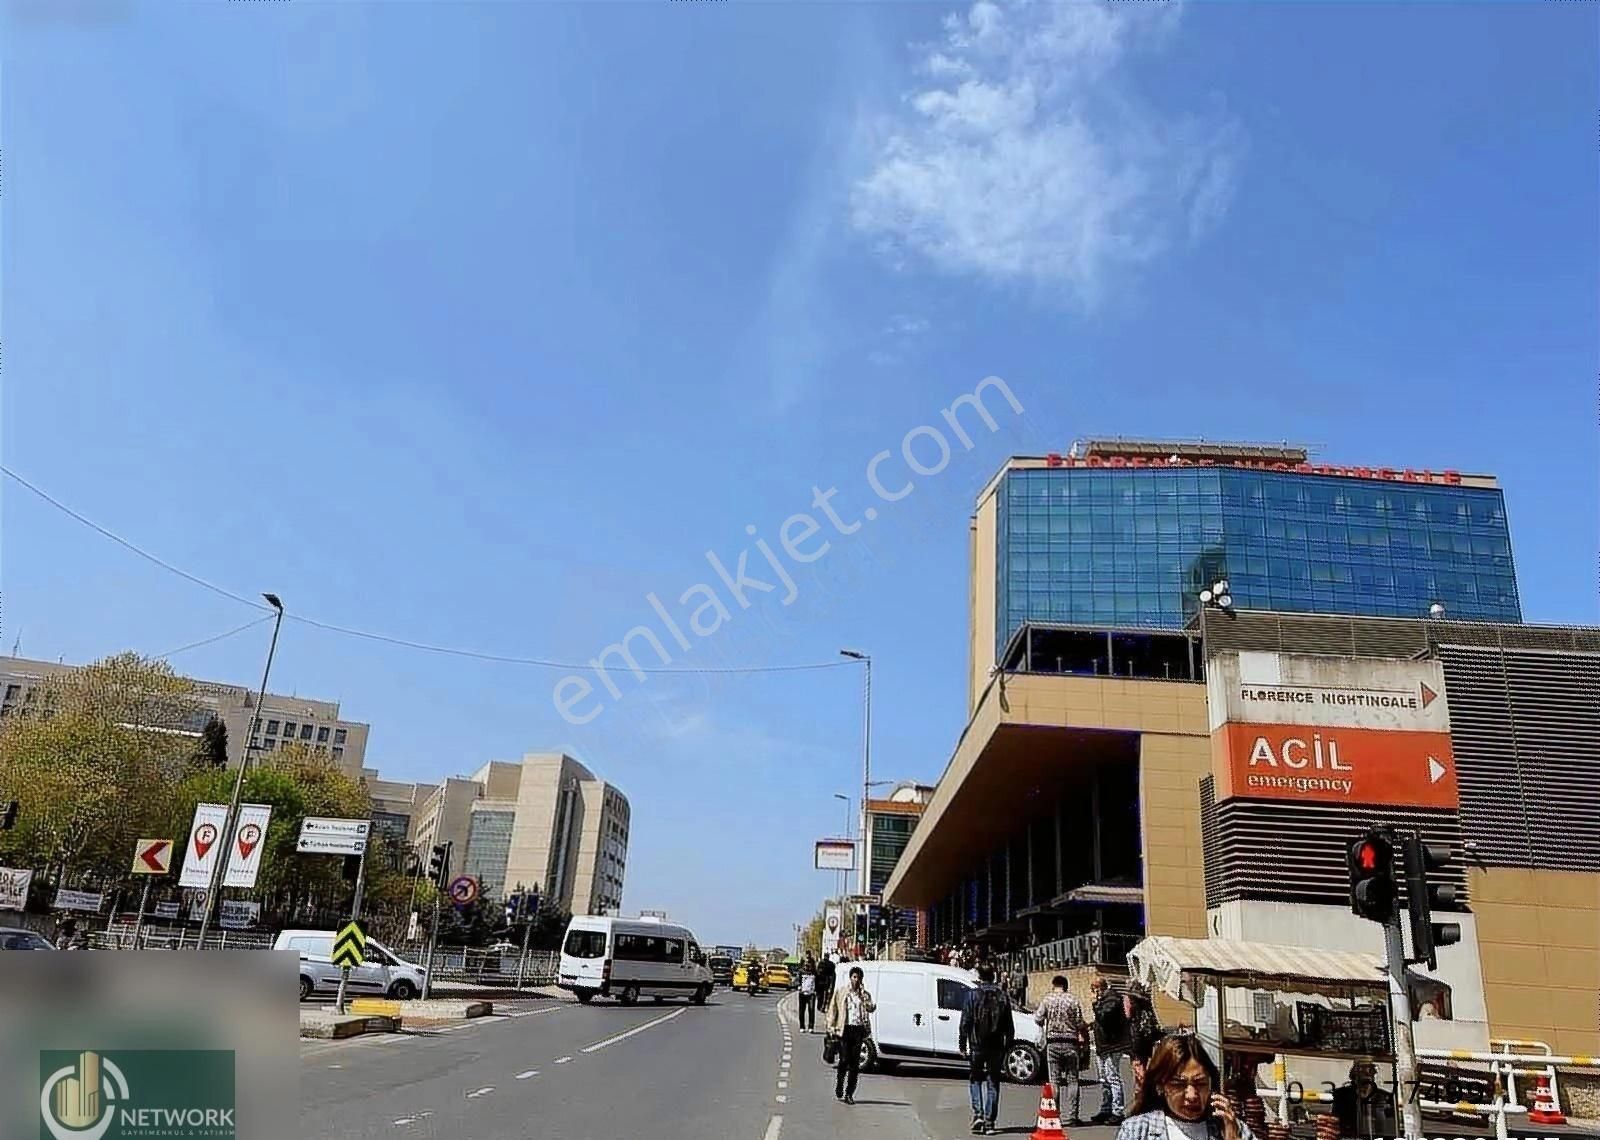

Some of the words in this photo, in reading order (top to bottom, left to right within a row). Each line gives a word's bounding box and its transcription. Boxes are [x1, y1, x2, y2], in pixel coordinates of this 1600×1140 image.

[1241, 689, 1314, 703] FLORENCE
[1322, 693, 1417, 708] NIGHTINGALE
[1249, 733, 1353, 771] ACİL
[1248, 774, 1353, 793] emergency
